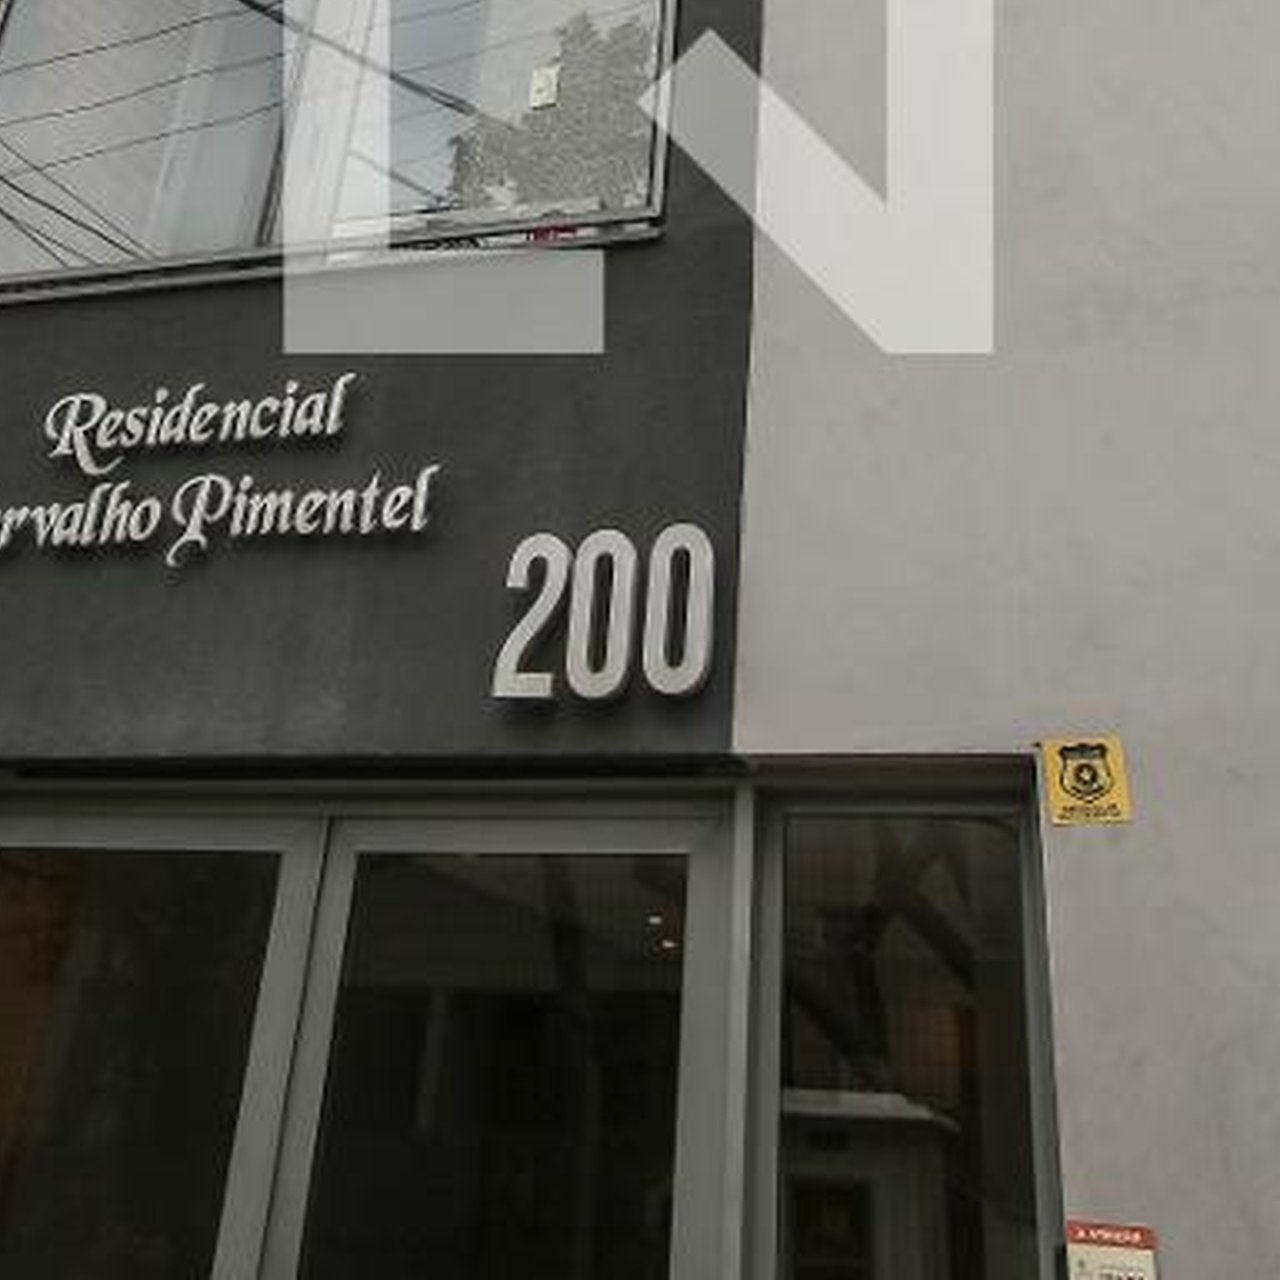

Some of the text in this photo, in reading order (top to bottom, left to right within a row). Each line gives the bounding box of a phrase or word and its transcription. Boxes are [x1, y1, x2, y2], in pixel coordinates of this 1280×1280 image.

[43, 372, 357, 476] Residencial
[165, 464, 440, 567] Pimentel
[491, 523, 715, 699] 200
